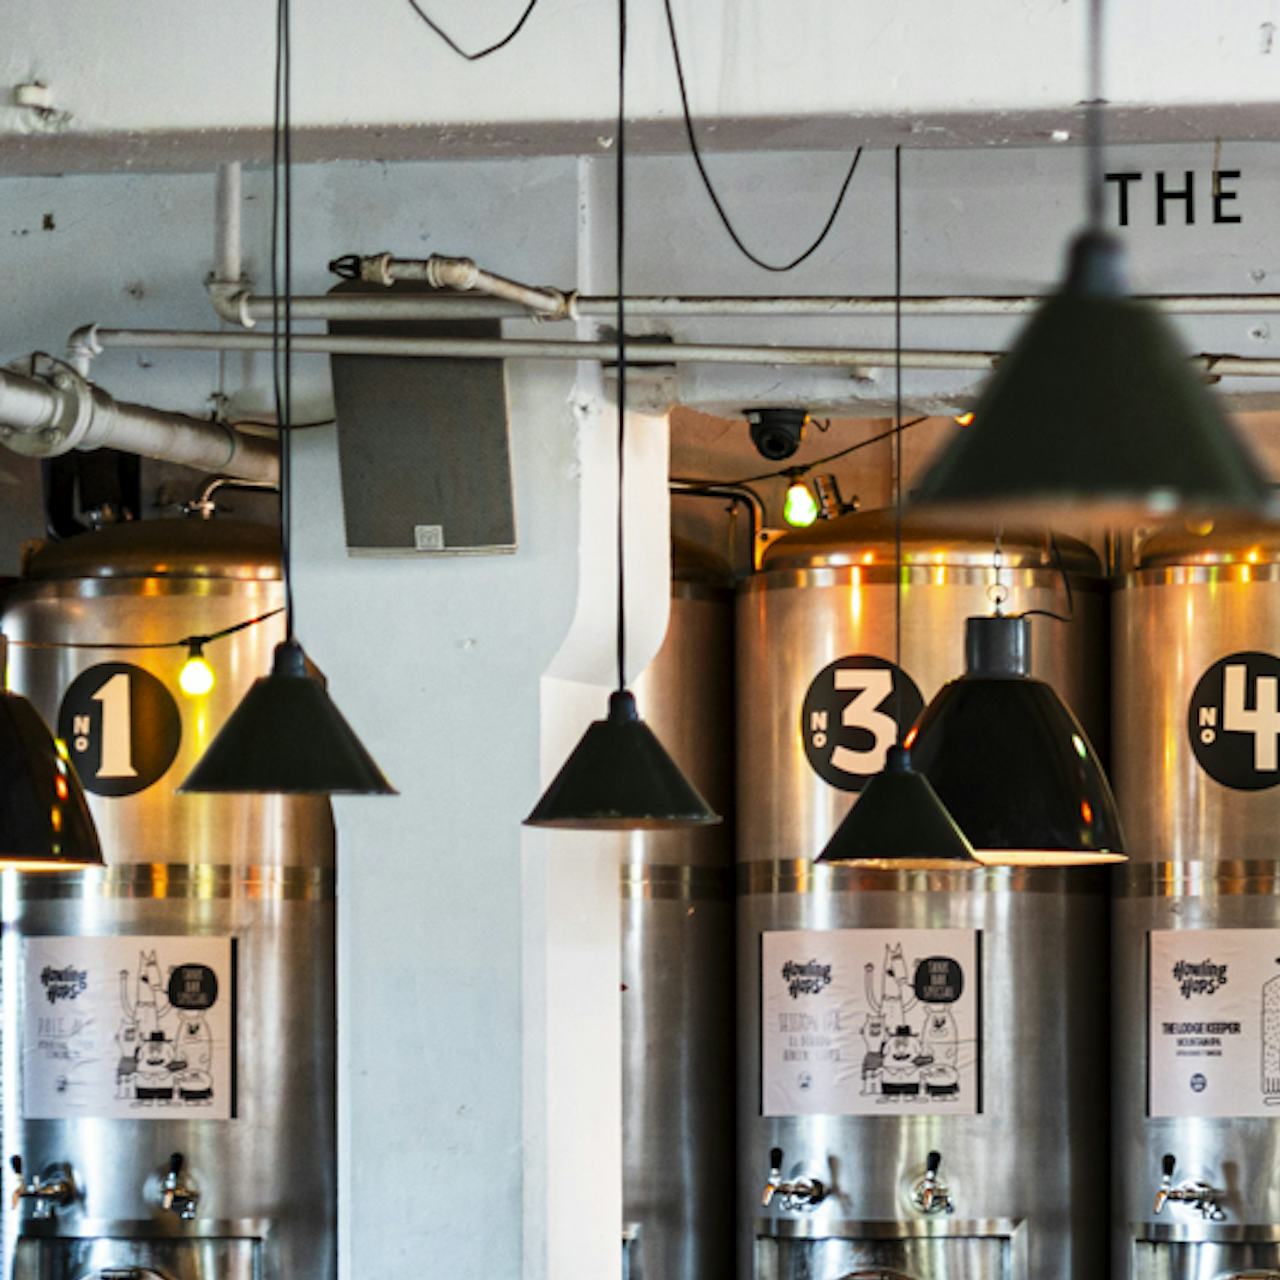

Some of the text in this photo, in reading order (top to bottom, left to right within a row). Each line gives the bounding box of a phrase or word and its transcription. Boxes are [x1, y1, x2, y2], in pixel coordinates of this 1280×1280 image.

[1105, 169, 1242, 227] THE
[91, 672, 139, 778] 1
[829, 668, 899, 776] 3
